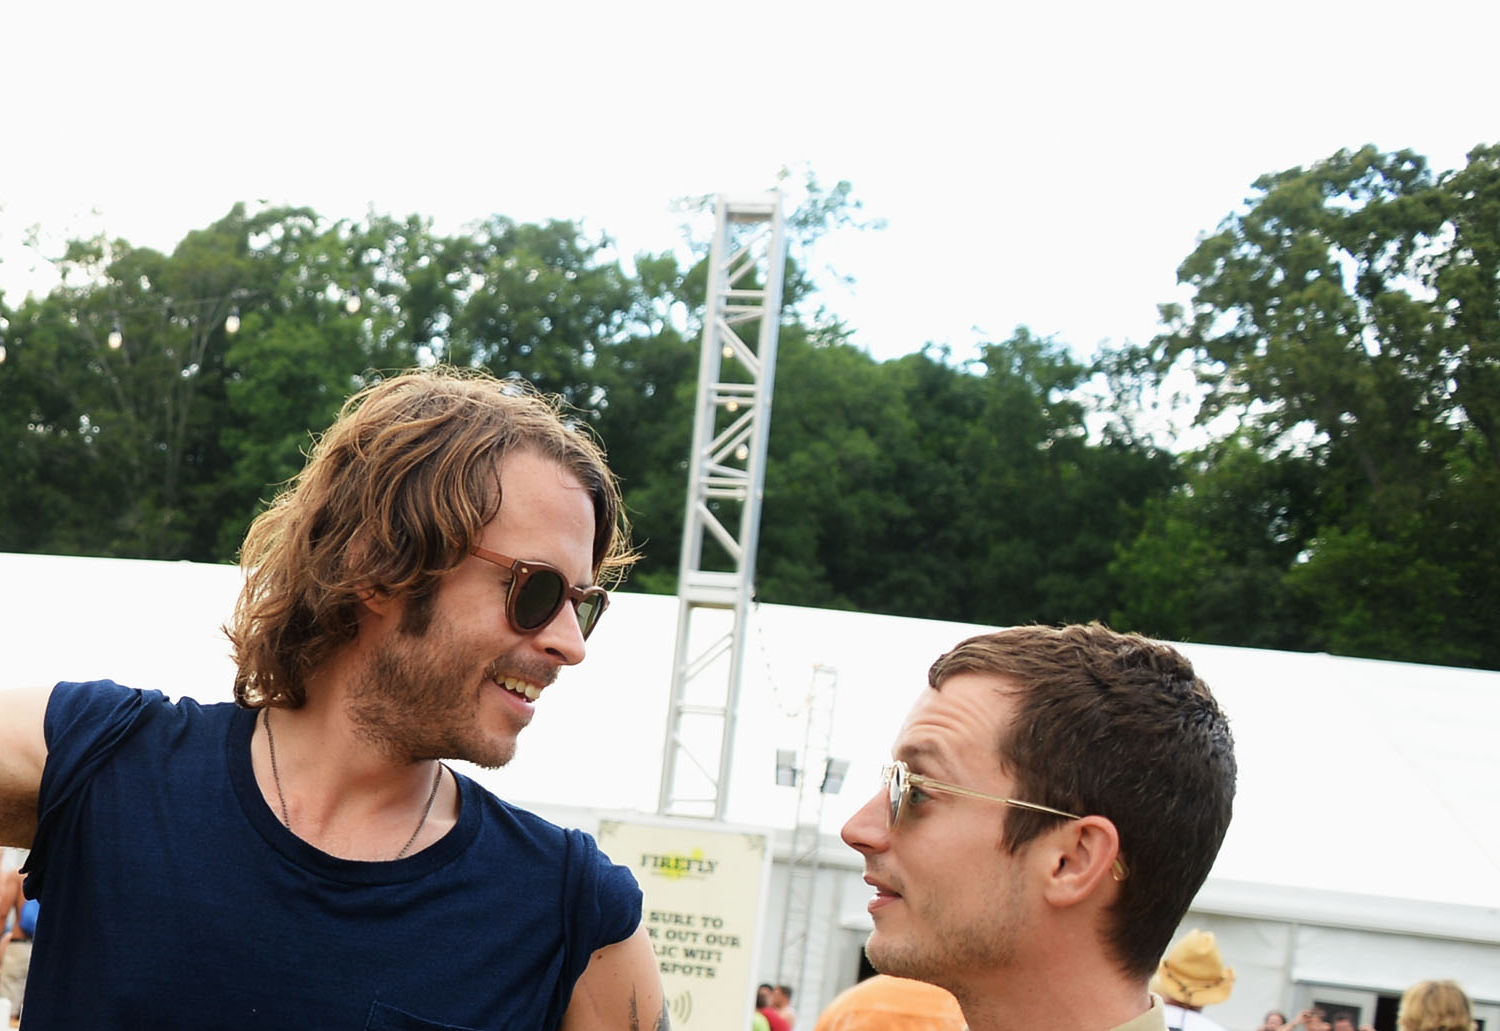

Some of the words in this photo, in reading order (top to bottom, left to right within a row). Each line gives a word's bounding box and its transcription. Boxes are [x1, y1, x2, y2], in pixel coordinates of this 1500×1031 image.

[641, 853, 719, 873] FIREFLY
[649, 911, 695, 926] SURE
[701, 917, 724, 929] TO
[665, 929, 699, 942] OUT
[706, 934, 741, 948] OUR
[660, 962, 716, 978] SPOTS
